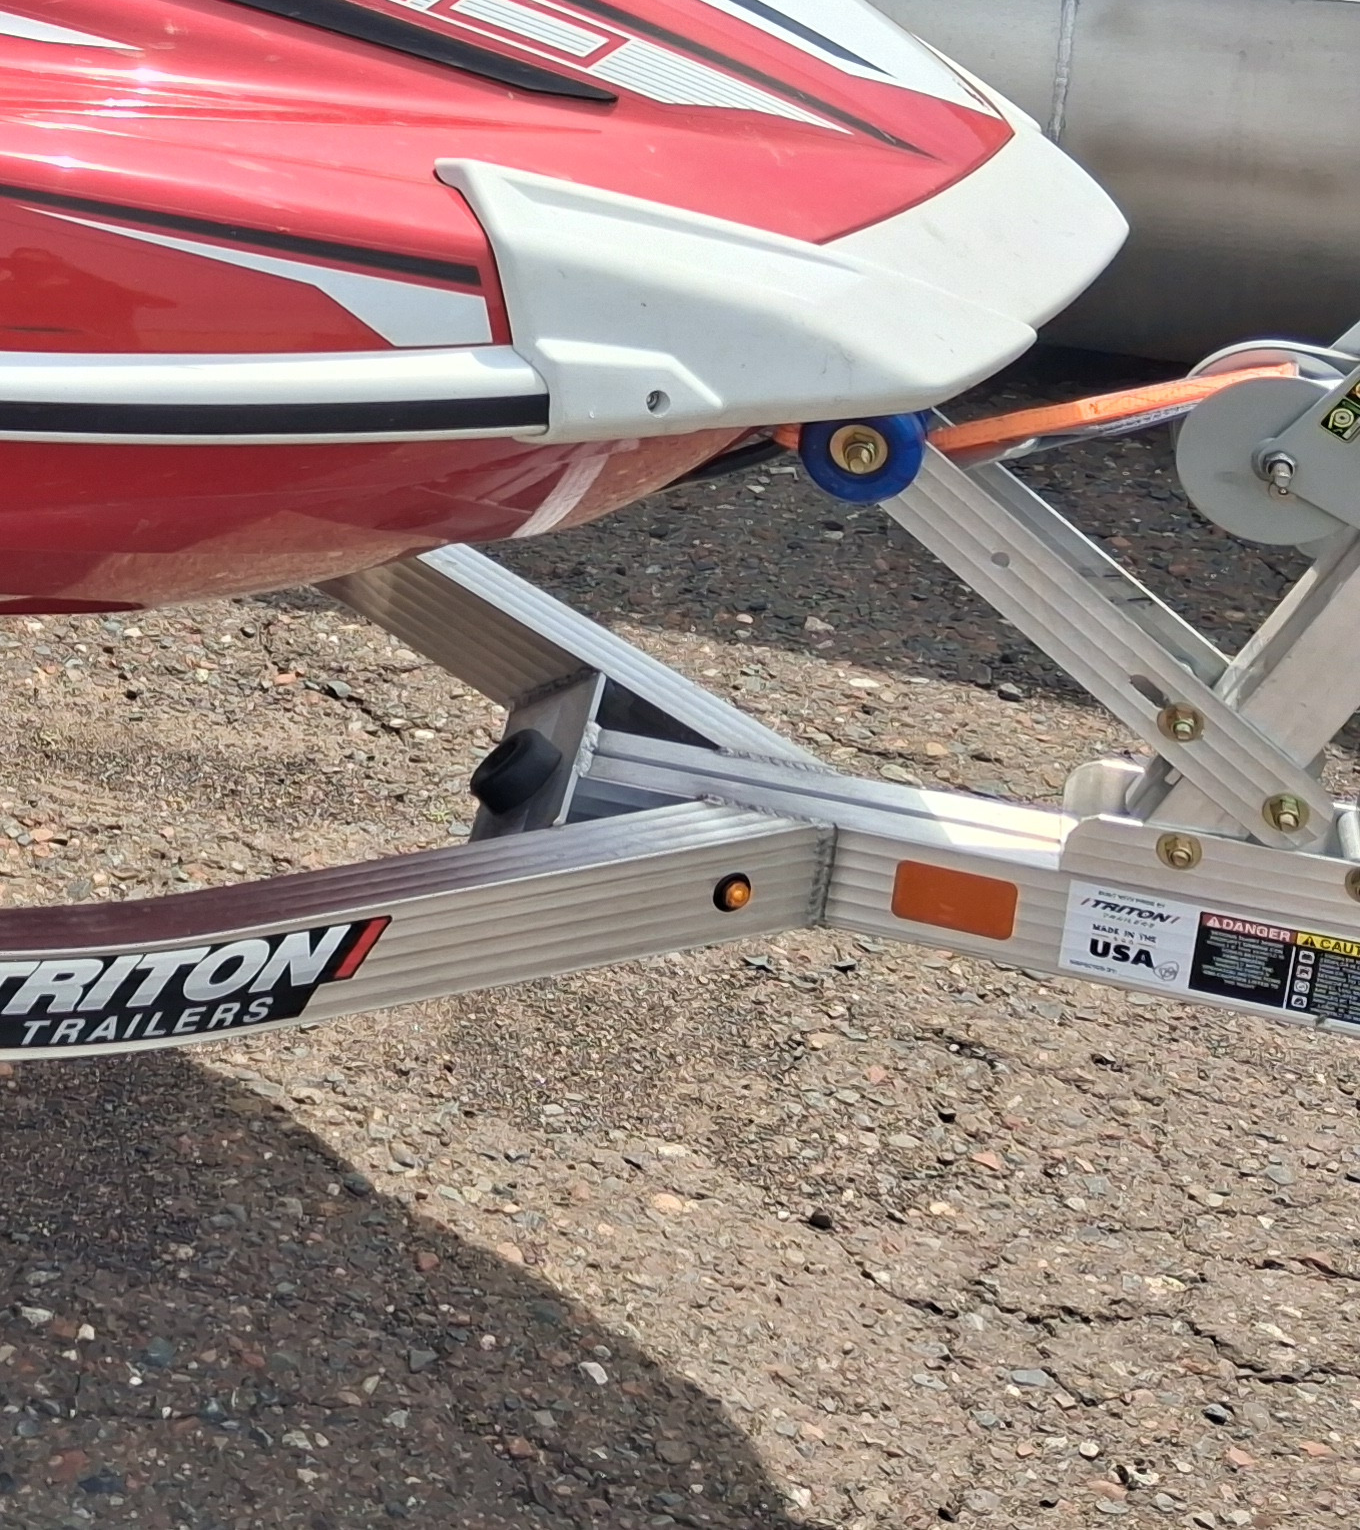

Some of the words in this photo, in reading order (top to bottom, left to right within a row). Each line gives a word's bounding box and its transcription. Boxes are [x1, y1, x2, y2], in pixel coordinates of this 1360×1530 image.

[1091, 899, 1172, 923] TRITON
[1092, 923, 1120, 936] MADE
[1123, 930, 1136, 939] IN
[1139, 933, 1157, 944] THE
[1222, 919, 1291, 943] DANGER
[1089, 938, 1154, 969] USA
[21, 996, 275, 1047] TRAILERS
